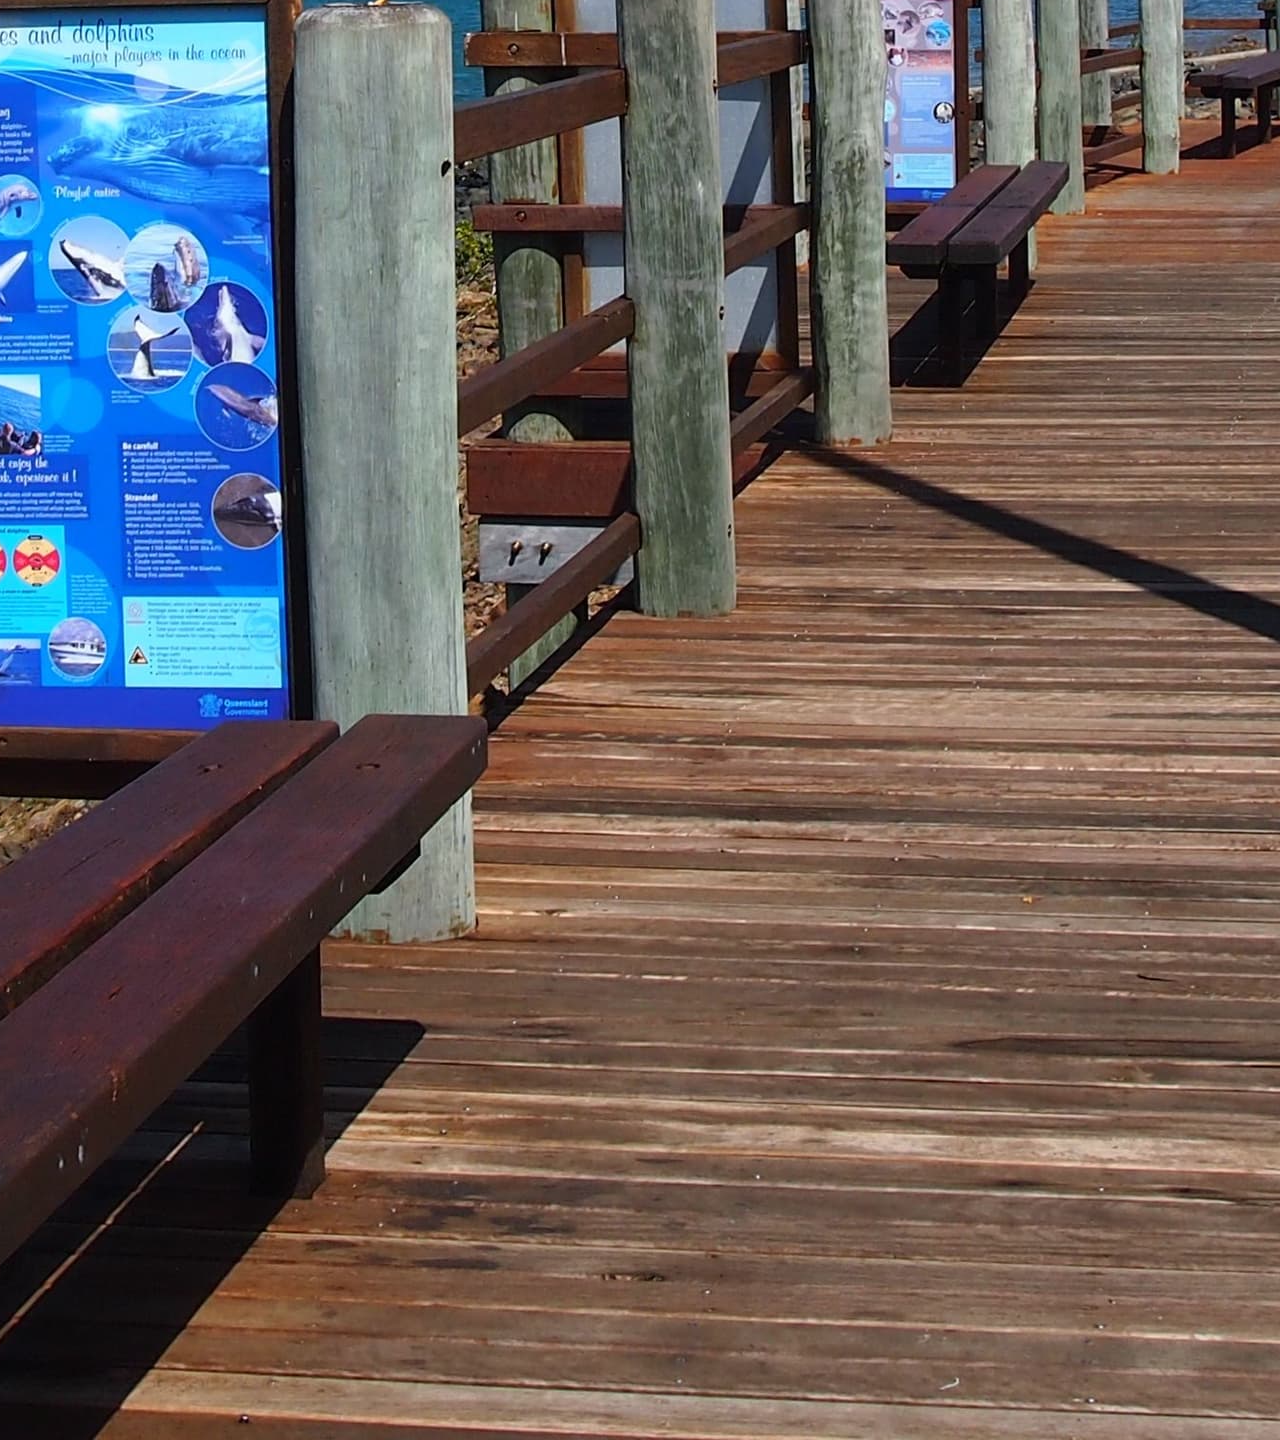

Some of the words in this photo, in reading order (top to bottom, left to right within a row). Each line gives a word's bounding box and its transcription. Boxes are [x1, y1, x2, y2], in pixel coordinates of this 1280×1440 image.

[28, 19, 63, 45] and
[72, 18, 154, 51] dolphins
[114, 46, 162, 67] players
[168, 48, 180, 61] in
[186, 44, 205, 61] the
[210, 48, 247, 60] ocean
[54, 185, 90, 202] Playful
[94, 187, 120, 198] antics
[122, 442, 132, 450] Be
[132, 441, 159, 450] careful!
[8, 458, 32, 472] enjoy
[35, 456, 48, 469] the
[15, 473, 60, 486] experience
[62, 472, 69, 483] it
[124, 493, 159, 501] Stranded!
[223, 698, 269, 708] Queensland
[224, 708, 269, 717] Government
